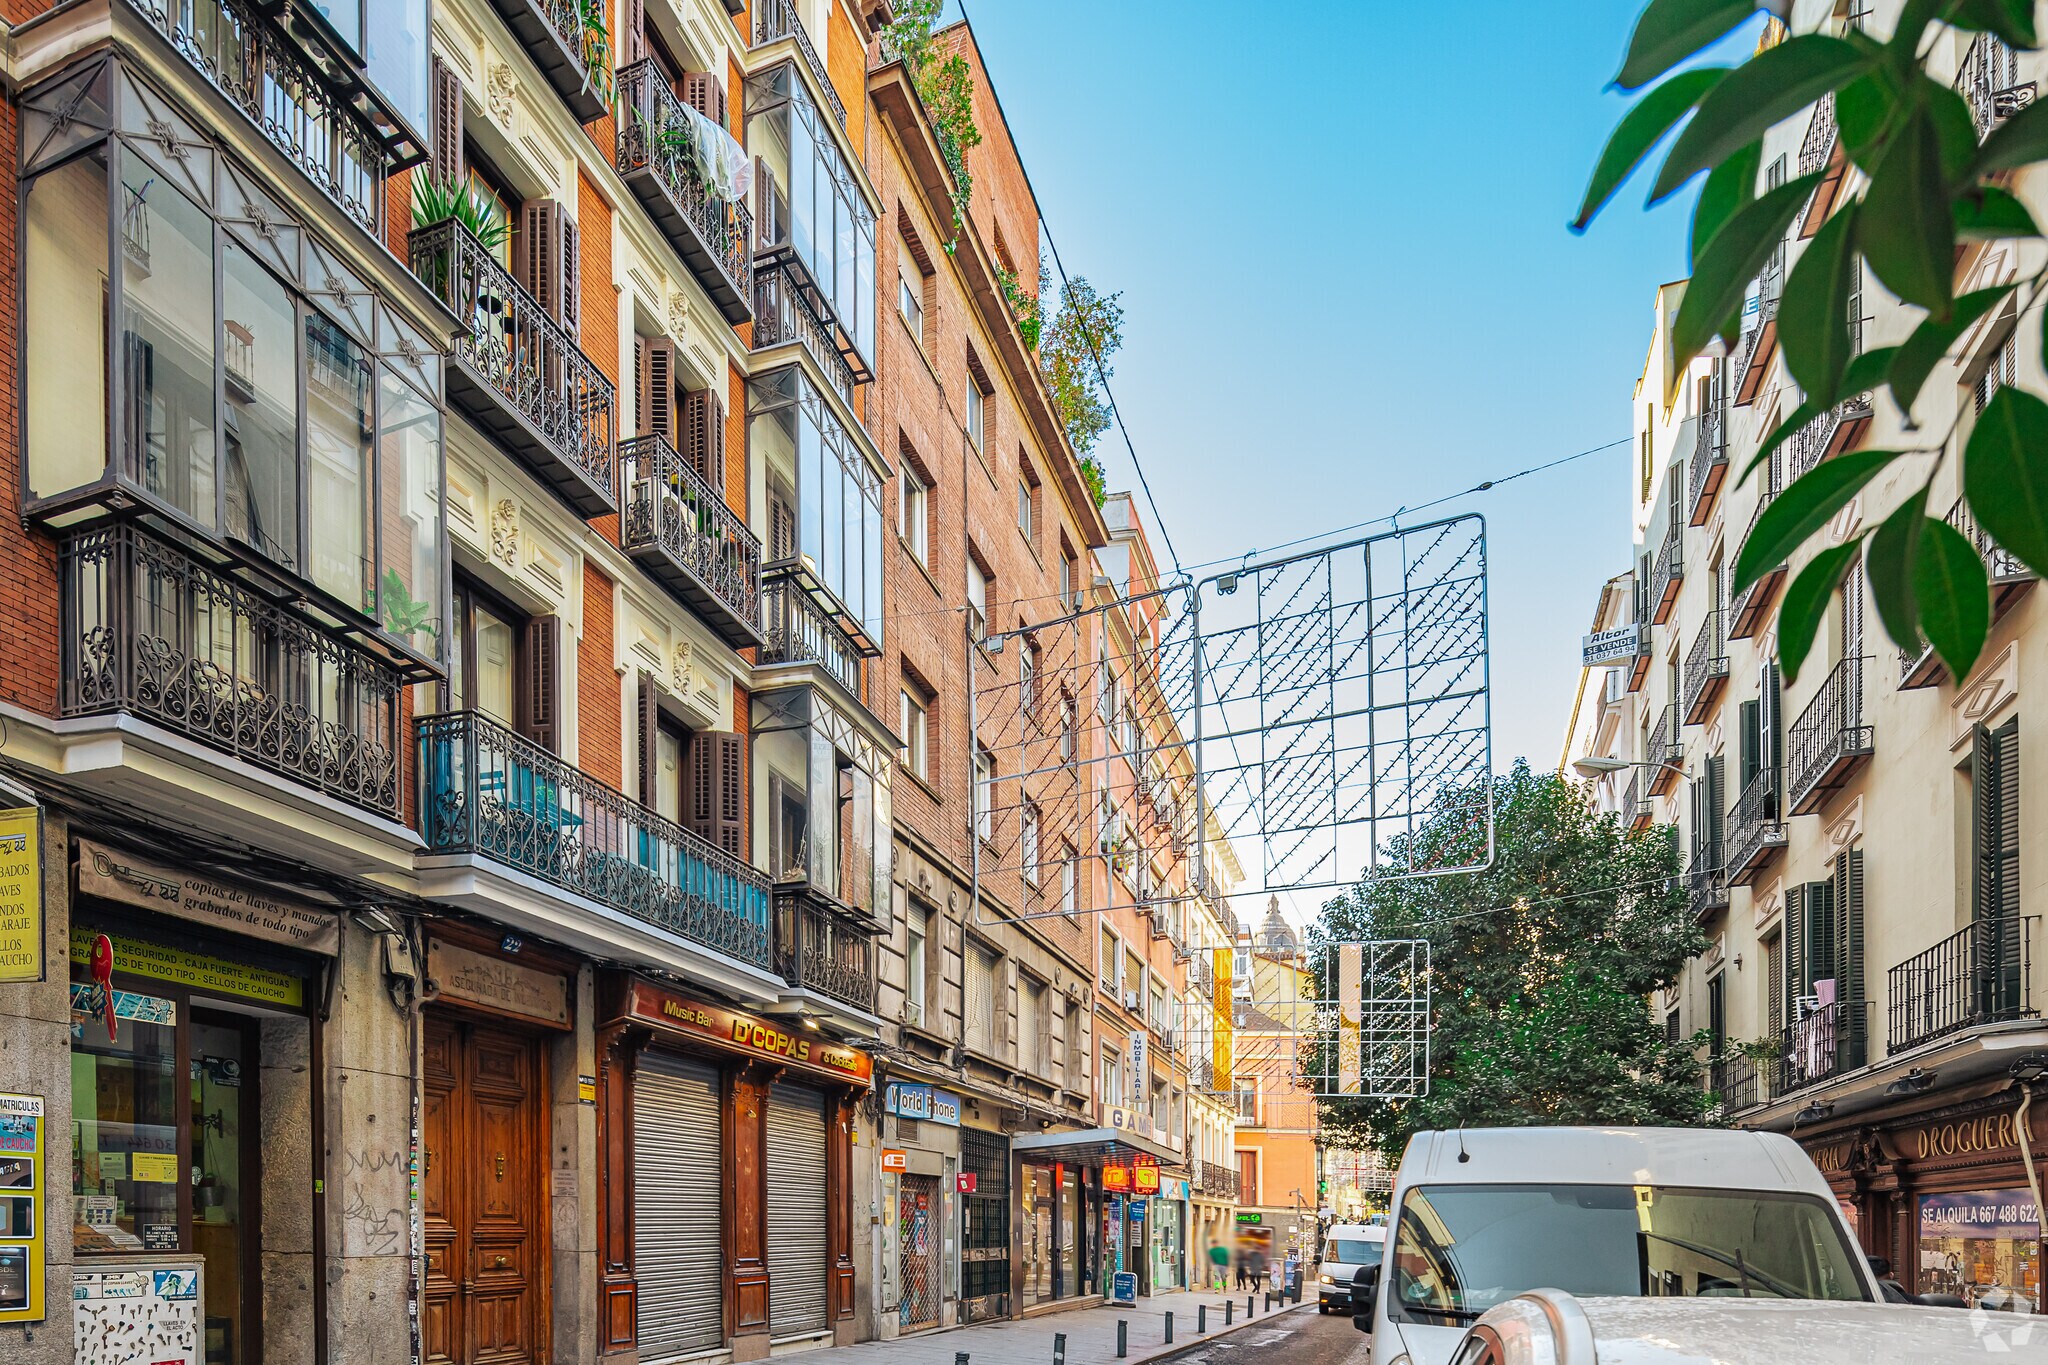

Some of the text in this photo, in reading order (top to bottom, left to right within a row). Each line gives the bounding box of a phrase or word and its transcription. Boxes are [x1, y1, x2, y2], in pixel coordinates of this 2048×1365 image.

[1587, 637, 1632, 655] SE VENDE
[1591, 629, 1630, 643] Altor
[183, 896, 309, 939] grabados de todo tipo
[185, 879, 331, 928] copias de llaves y mandos
[504, 936, 522, 953] 22
[122, 944, 177, 964] SEGURIDAD
[185, 958, 209, 971] CAJA
[210, 964, 243, 978] FUERTE
[250, 973, 290, 988] ANTIGUAS
[131, 960, 144, 970] DE
[146, 963, 173, 976] TODO
[175, 968, 195, 981] TIPO
[203, 975, 236, 989] SELLOS
[238, 982, 249, 992] DE
[251, 985, 285, 999] CAUCHO
[664, 999, 858, 1072] Music Bar D'COPAS & Cocktails
[1133, 1034, 1142, 1100] INMOBILIARIA
[891, 1085, 956, 1120] World Phone
[6, 1137, 35, 1151] CAUCHO
[1922, 1204, 2039, 1224] SE ALQUILA 667 488 622
